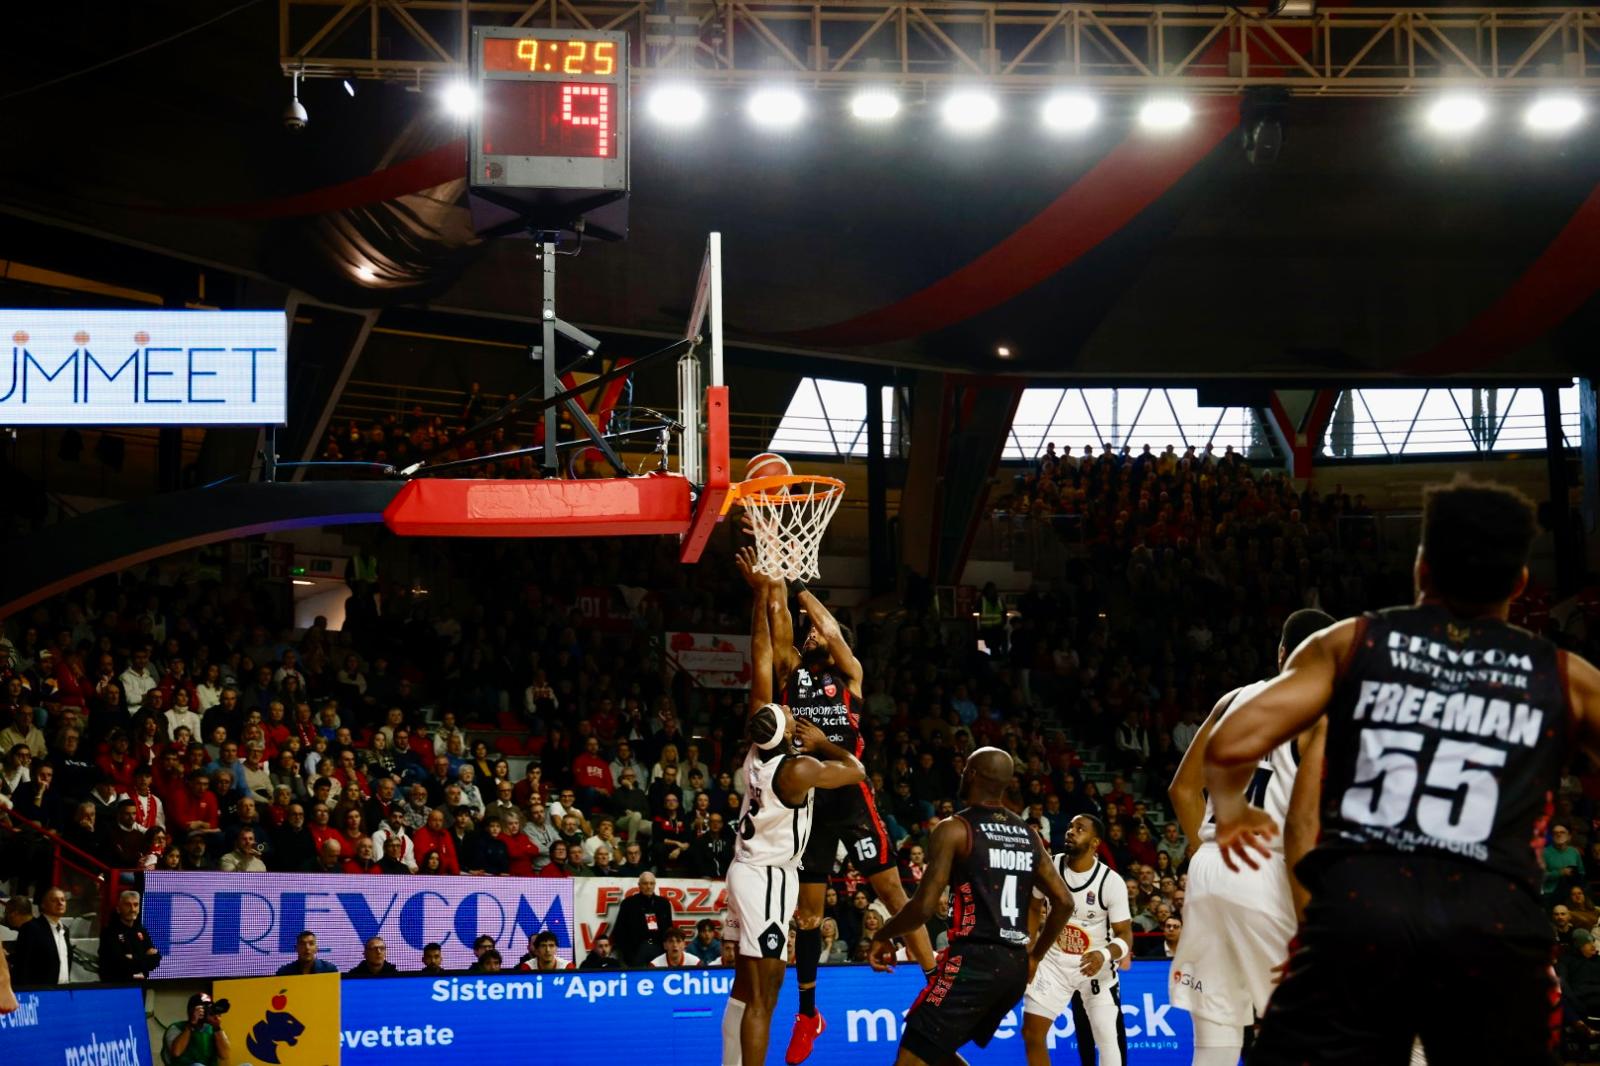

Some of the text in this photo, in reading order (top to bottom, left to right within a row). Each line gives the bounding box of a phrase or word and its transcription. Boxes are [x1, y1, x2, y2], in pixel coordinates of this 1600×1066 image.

[518, 39, 613, 75] 9:25
[562, 86, 609, 156] 9
[1388, 631, 1533, 671] PREVCOM
[1353, 680, 1543, 749] FREEMAN
[1341, 728, 1507, 844] 55
[854, 837, 877, 861] 15
[988, 848, 1034, 872] MOORE
[596, 886, 729, 915] FRZA
[1000, 874, 1020, 927] 4
[143, 891, 571, 957] PREVCOM
[431, 977, 543, 1002] Sistemi
[637, 977, 654, 996] e
[1091, 979, 1100, 995] 8
